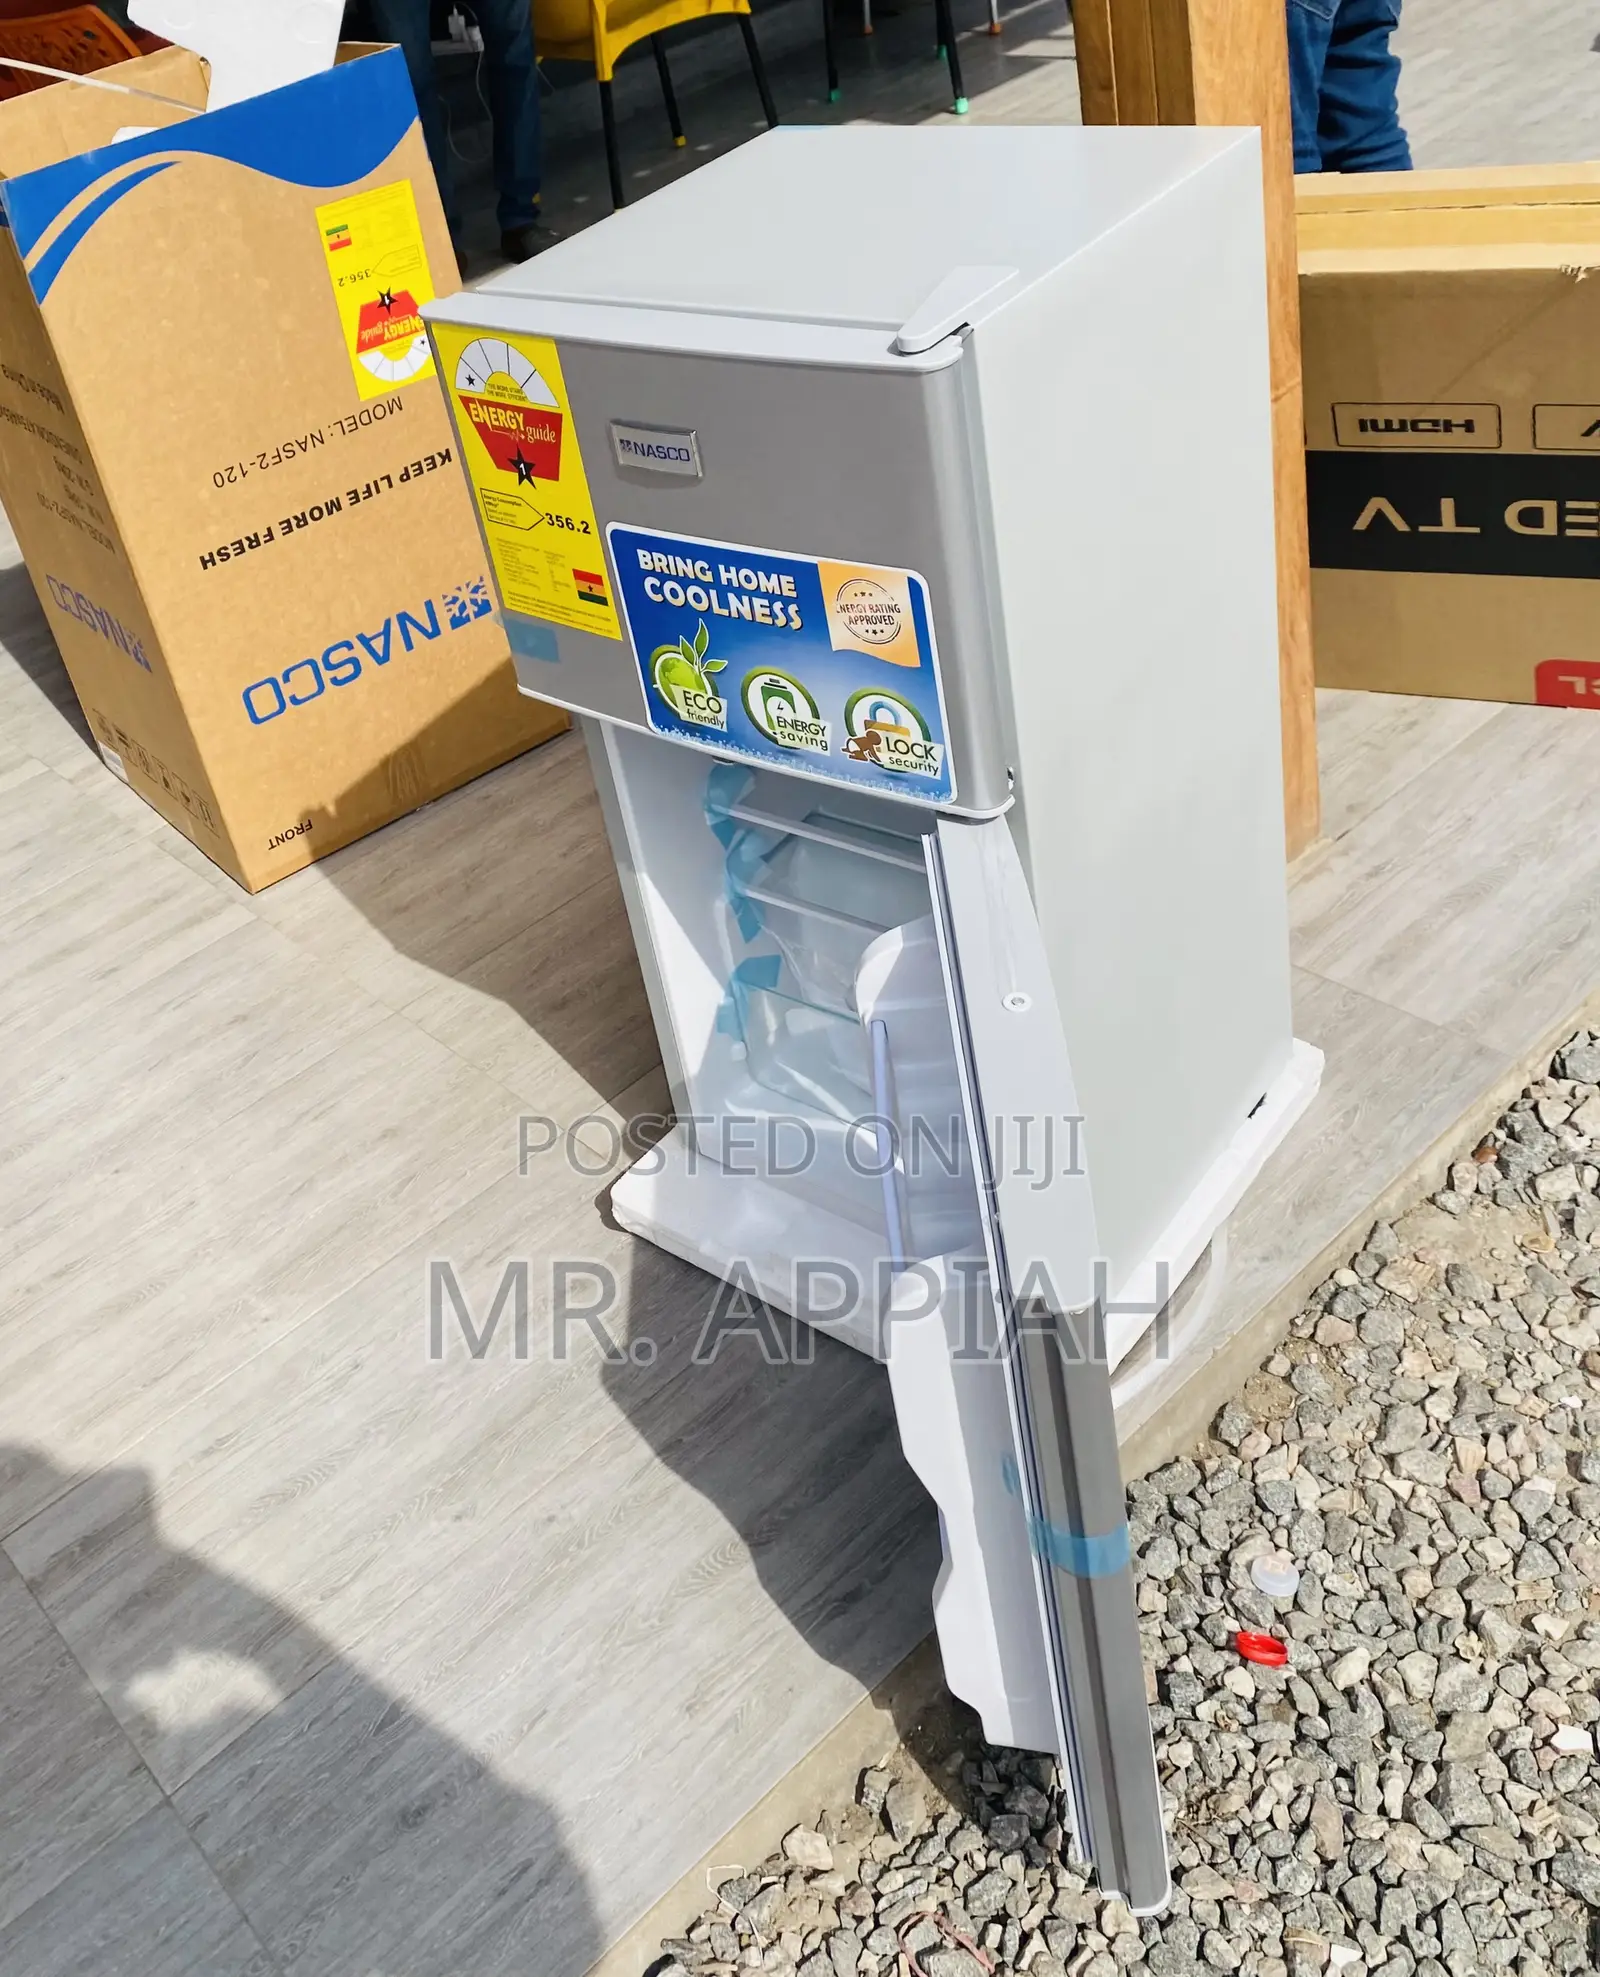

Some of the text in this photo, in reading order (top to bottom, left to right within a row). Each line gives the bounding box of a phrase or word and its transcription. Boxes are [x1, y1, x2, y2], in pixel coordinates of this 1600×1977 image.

[338, 269, 371, 287] 356.2
[361, 323, 383, 343] guide
[469, 399, 556, 443] ENERGY guide
[1358, 418, 1475, 433] HDMI
[213, 396, 404, 488] MODEL: NASF2-120
[633, 441, 691, 461] NASCO
[519, 463, 526, 475] 1
[199, 448, 453, 571] KEEP LIFE MORE FRESH
[1352, 496, 1481, 534] TV
[545, 512, 591, 535] 356.2
[636, 548, 798, 598] BRING HOME
[46, 574, 132, 656] NASCO
[643, 576, 804, 631] COOLNESS
[836, 603, 901, 614] NERGY RATING
[848, 615, 895, 625] APPROVED
[242, 599, 442, 726] NASCO
[682, 690, 722, 714] ECO
[686, 708, 725, 730] friendly
[776, 716, 827, 737] ENERGY
[780, 731, 828, 752] saving
[886, 736, 937, 762] LOCK
[889, 756, 939, 776] security
[267, 819, 314, 851] FRONT
